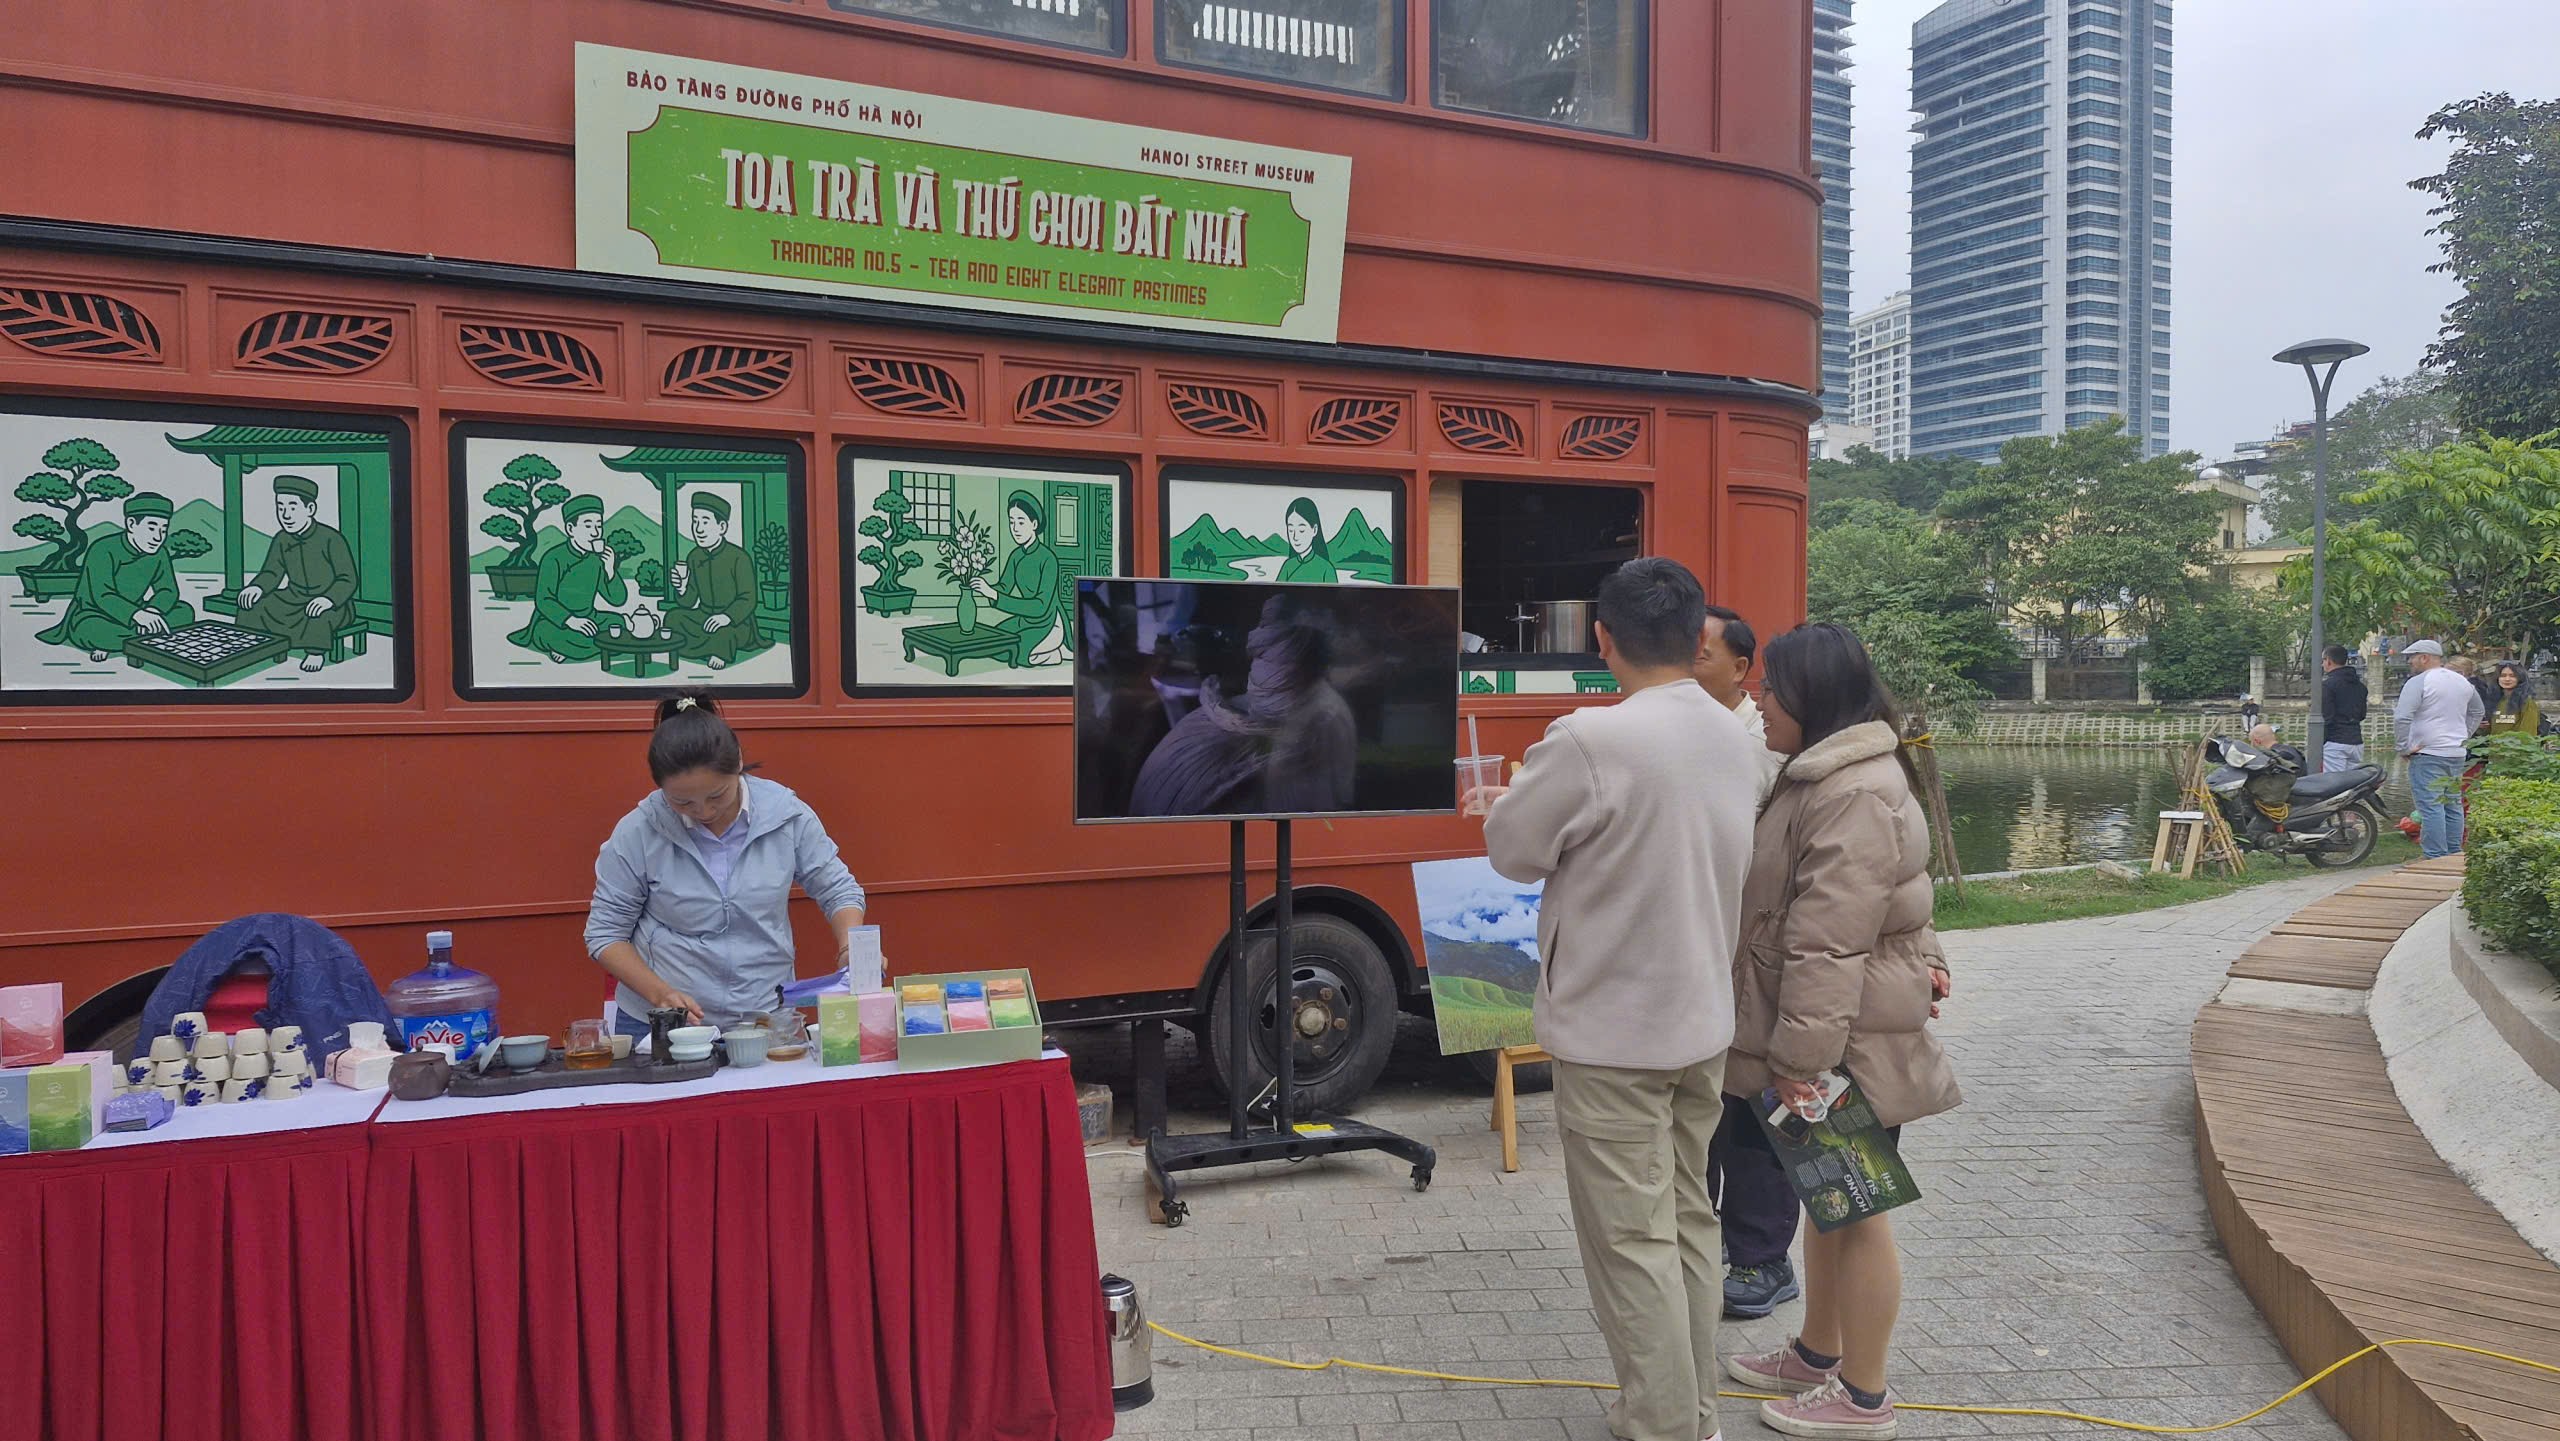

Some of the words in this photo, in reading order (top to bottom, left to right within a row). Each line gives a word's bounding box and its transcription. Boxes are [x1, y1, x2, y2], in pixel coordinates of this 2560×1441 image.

[627, 69, 667, 91] BẢO
[677, 77, 727, 100] TÀNG
[736, 87, 802, 111] ĐƯỜNG
[812, 98, 851, 118] PHỐ
[859, 105, 882, 123] HÀ
[891, 109, 922, 129] NỘI
[1141, 147, 1189, 167] HANOI
[1197, 155, 1248, 175] STREET
[1255, 163, 1315, 184] MUSEUM
[721, 148, 798, 216] TOA
[808, 156, 883, 226] TRÀ
[894, 165, 942, 233] VÀ
[953, 176, 1023, 241] THÚ
[1029, 189, 1106, 252] CHƠI
[1112, 194, 1177, 260] BÁT
[1183, 206, 1249, 268] NHÃ
[770, 240, 855, 268] TRAMCAR
[864, 250, 901, 273] NO.5
[929, 257, 959, 280] TEA
[968, 262, 998, 284] AND
[1006, 266, 1052, 290] EIGHT
[1058, 272, 1126, 297] ELEGANT
[1133, 279, 1207, 306] PASTIMES
